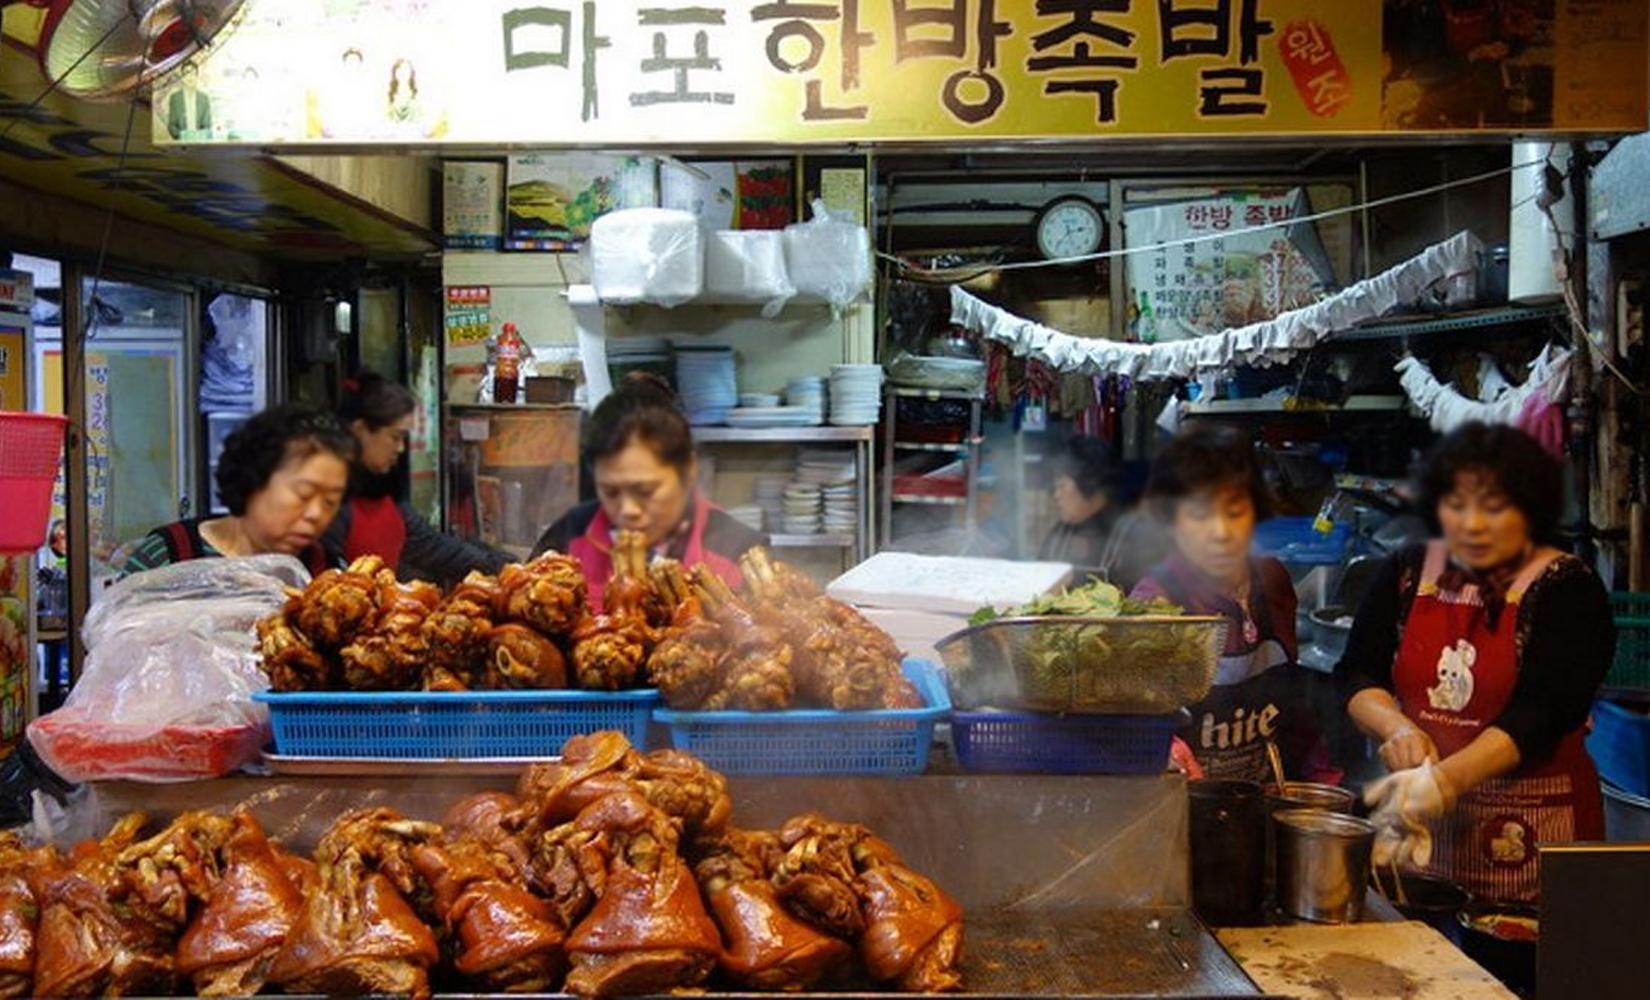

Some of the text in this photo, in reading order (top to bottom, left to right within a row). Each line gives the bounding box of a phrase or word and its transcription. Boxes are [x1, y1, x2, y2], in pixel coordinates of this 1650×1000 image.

[1286, 20, 1350, 118] 원조
[1184, 204, 1233, 230] 한방
[1201, 703, 1280, 749] hite
